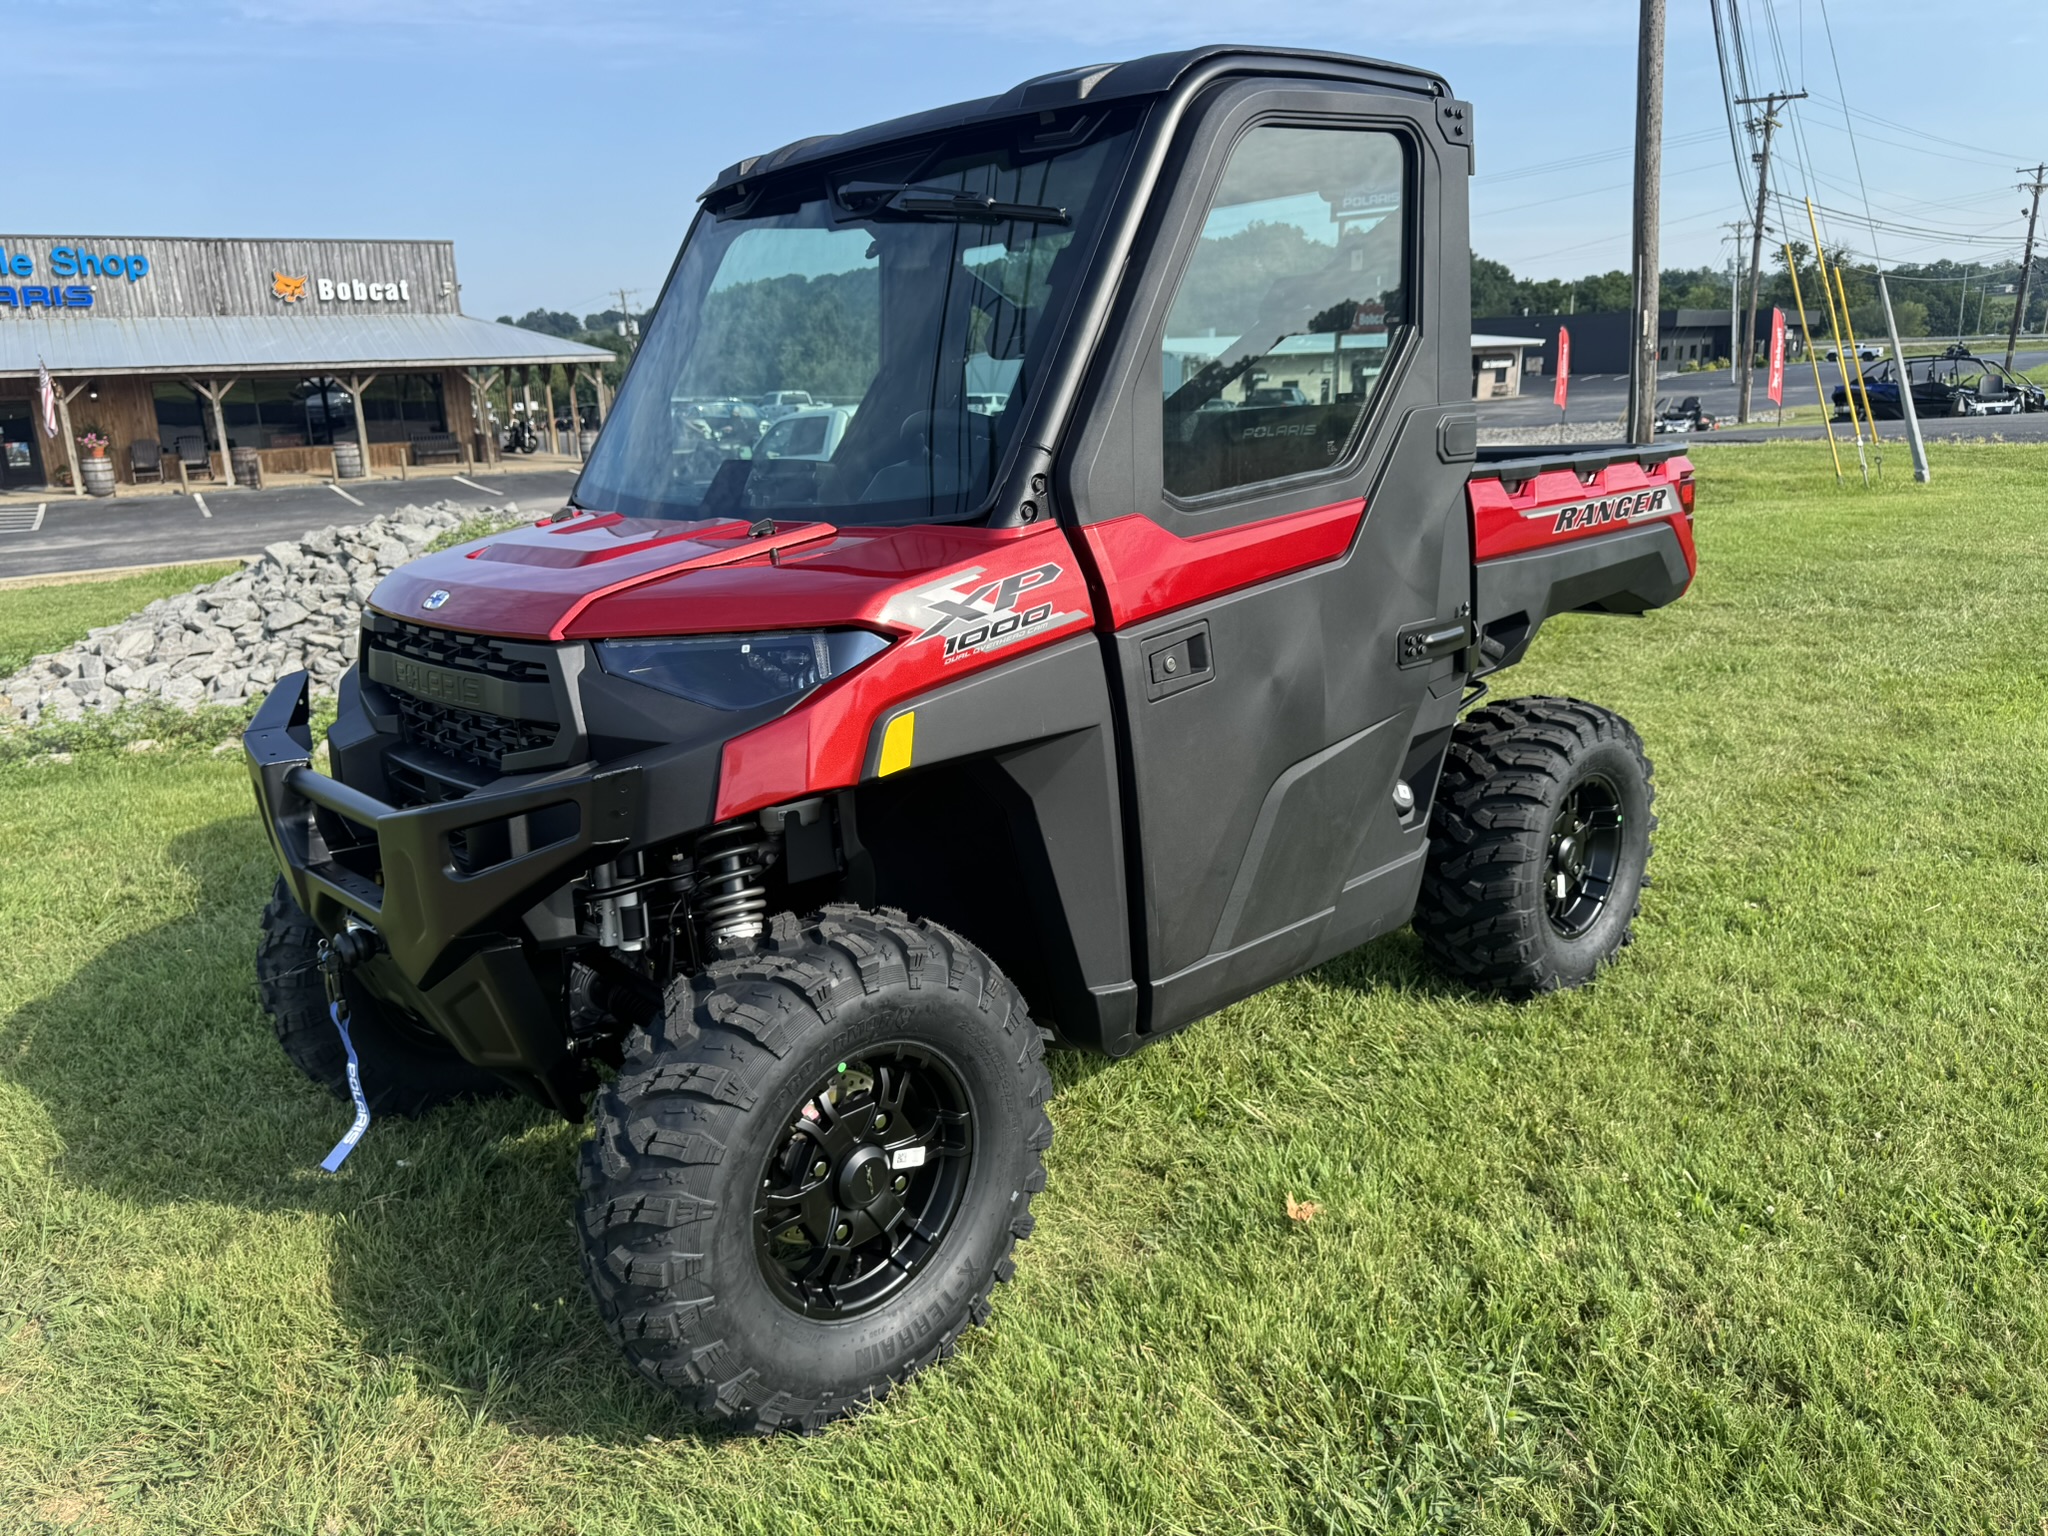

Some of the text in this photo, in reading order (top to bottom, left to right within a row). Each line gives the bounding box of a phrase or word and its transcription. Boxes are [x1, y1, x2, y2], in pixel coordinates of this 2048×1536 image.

[51, 246, 149, 282] Shop
[318, 278, 409, 301] Bobcat
[1242, 424, 1317, 440] POLARIS
[1552, 488, 1667, 534] RANGER
[907, 562, 1063, 646] XP
[943, 602, 1053, 659] 1000
[944, 621, 1049, 665] DUAL OVERHEAD CAM
[394, 660, 481, 706] POLARIS
[343, 1062, 369, 1145] POLARIS
[854, 1255, 980, 1373] X-TERRAIN
